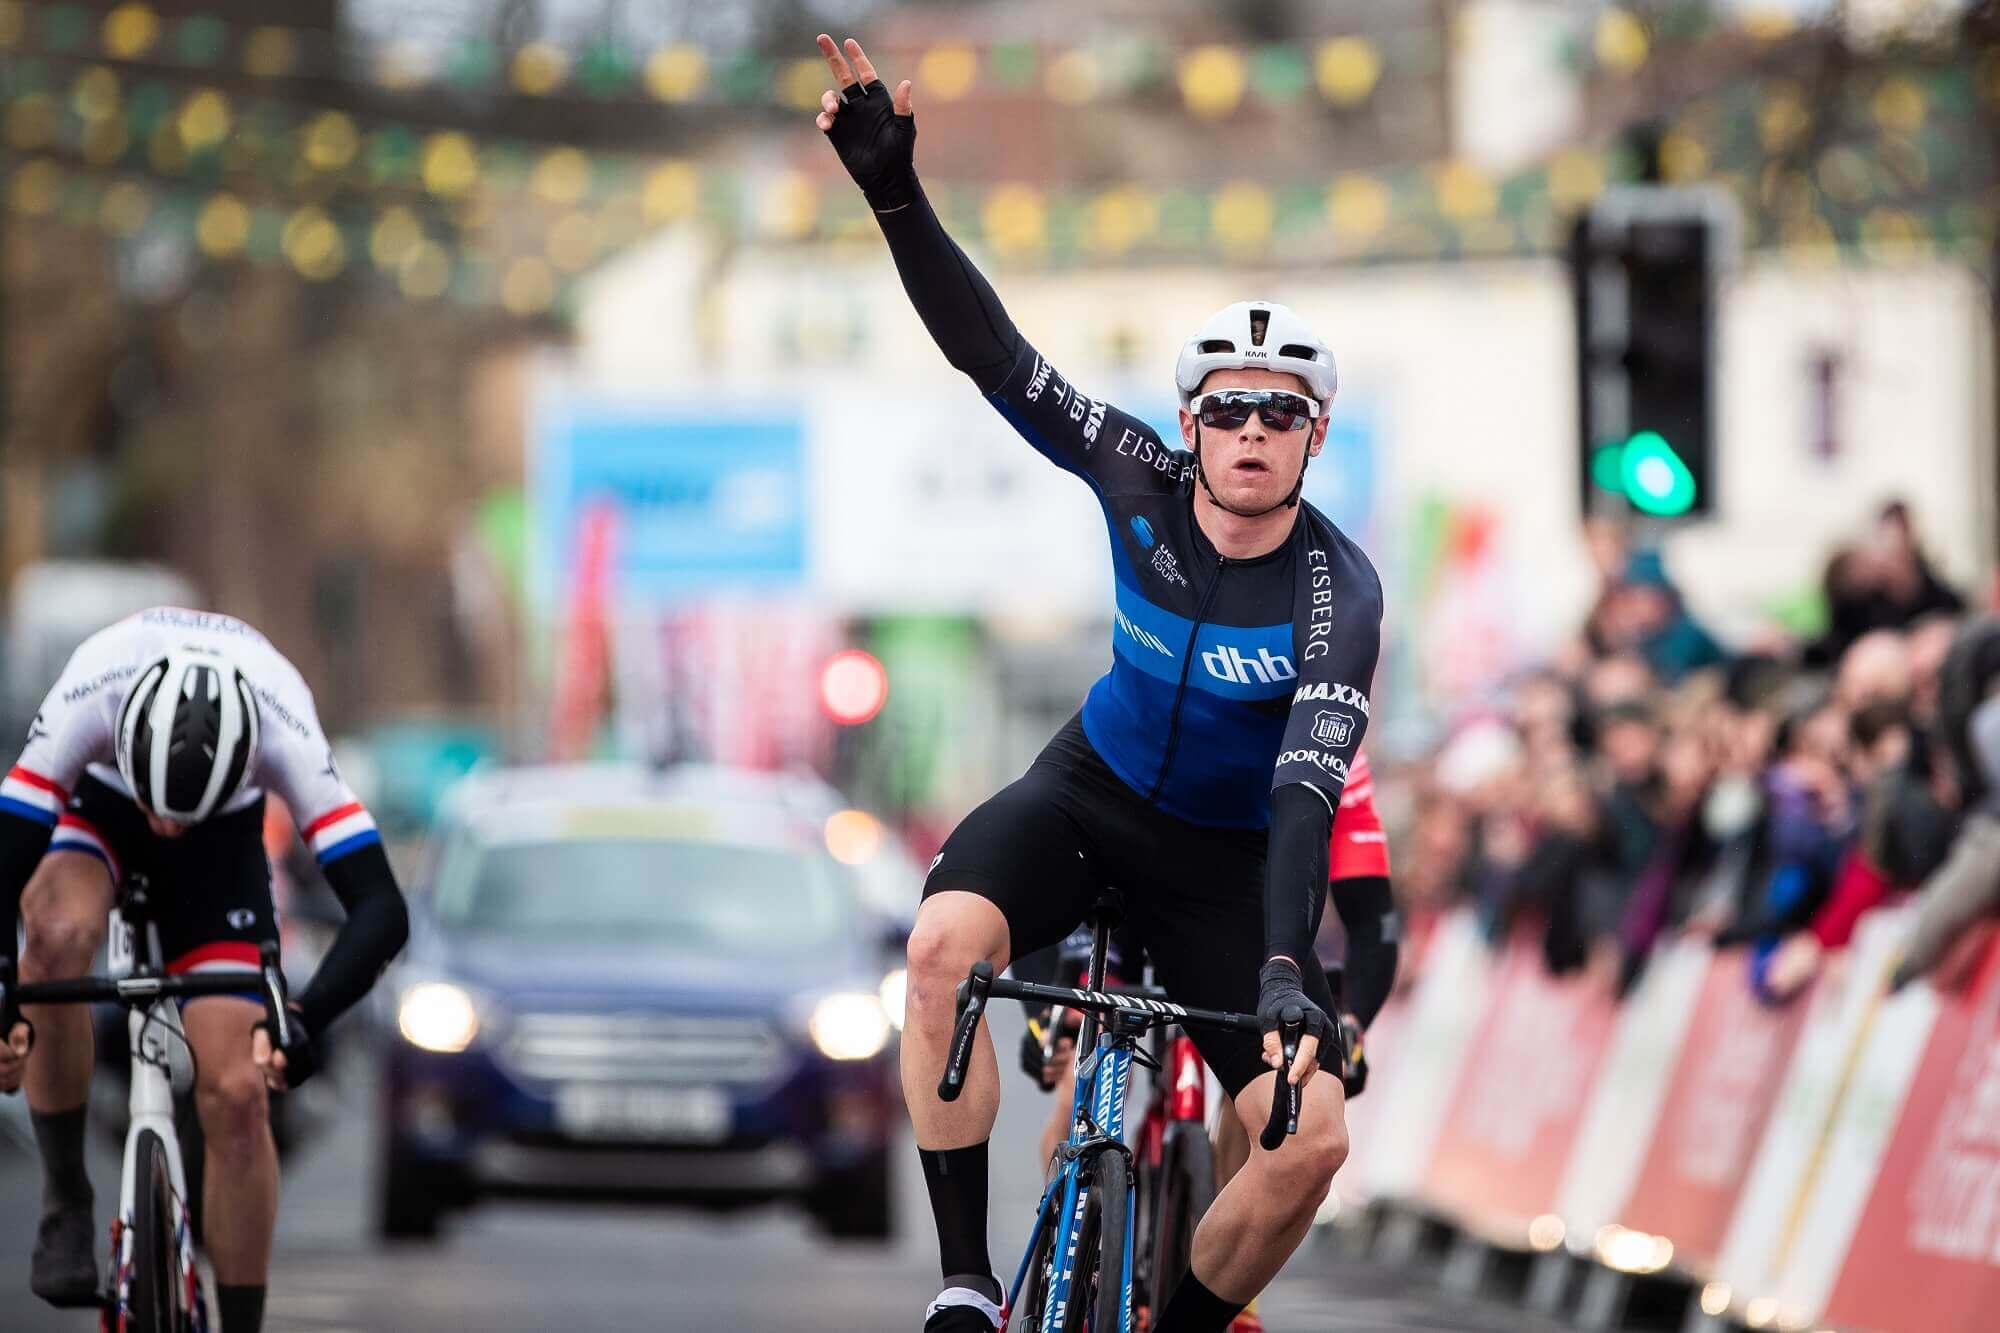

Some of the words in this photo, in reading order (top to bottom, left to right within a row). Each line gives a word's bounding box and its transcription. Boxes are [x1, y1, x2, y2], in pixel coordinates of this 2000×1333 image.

[1245, 350, 1268, 359] KASK
[1026, 360, 1052, 402] OMES
[1151, 555, 1175, 585] TOUR
[1154, 549, 1188, 588] EUROPE
[1160, 543, 1177, 566] UCI
[1304, 549, 1332, 661] EISBERG
[1201, 644, 1299, 684] dhb
[1317, 719, 1347, 742] Line
